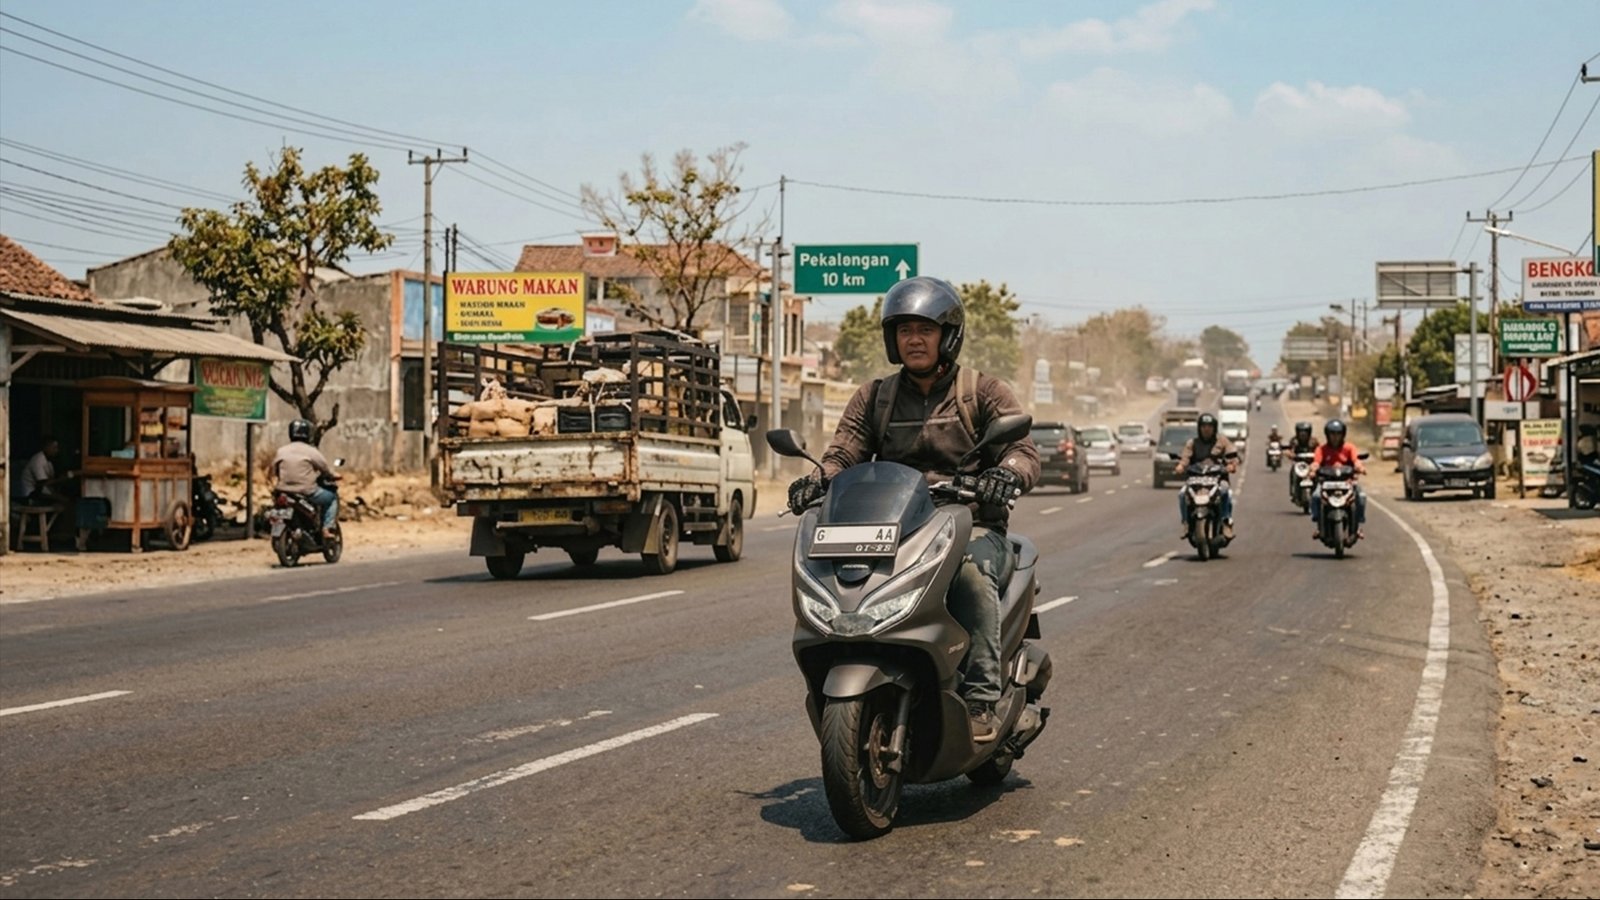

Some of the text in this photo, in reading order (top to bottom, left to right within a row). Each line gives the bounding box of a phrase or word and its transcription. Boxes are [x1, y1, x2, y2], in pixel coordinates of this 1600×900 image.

[800, 253, 889, 270] Pekalongan
[822, 272, 865, 286] 10 km
[452, 279, 578, 295] WARUNG MAKAN
[817, 528, 893, 541] G AA
